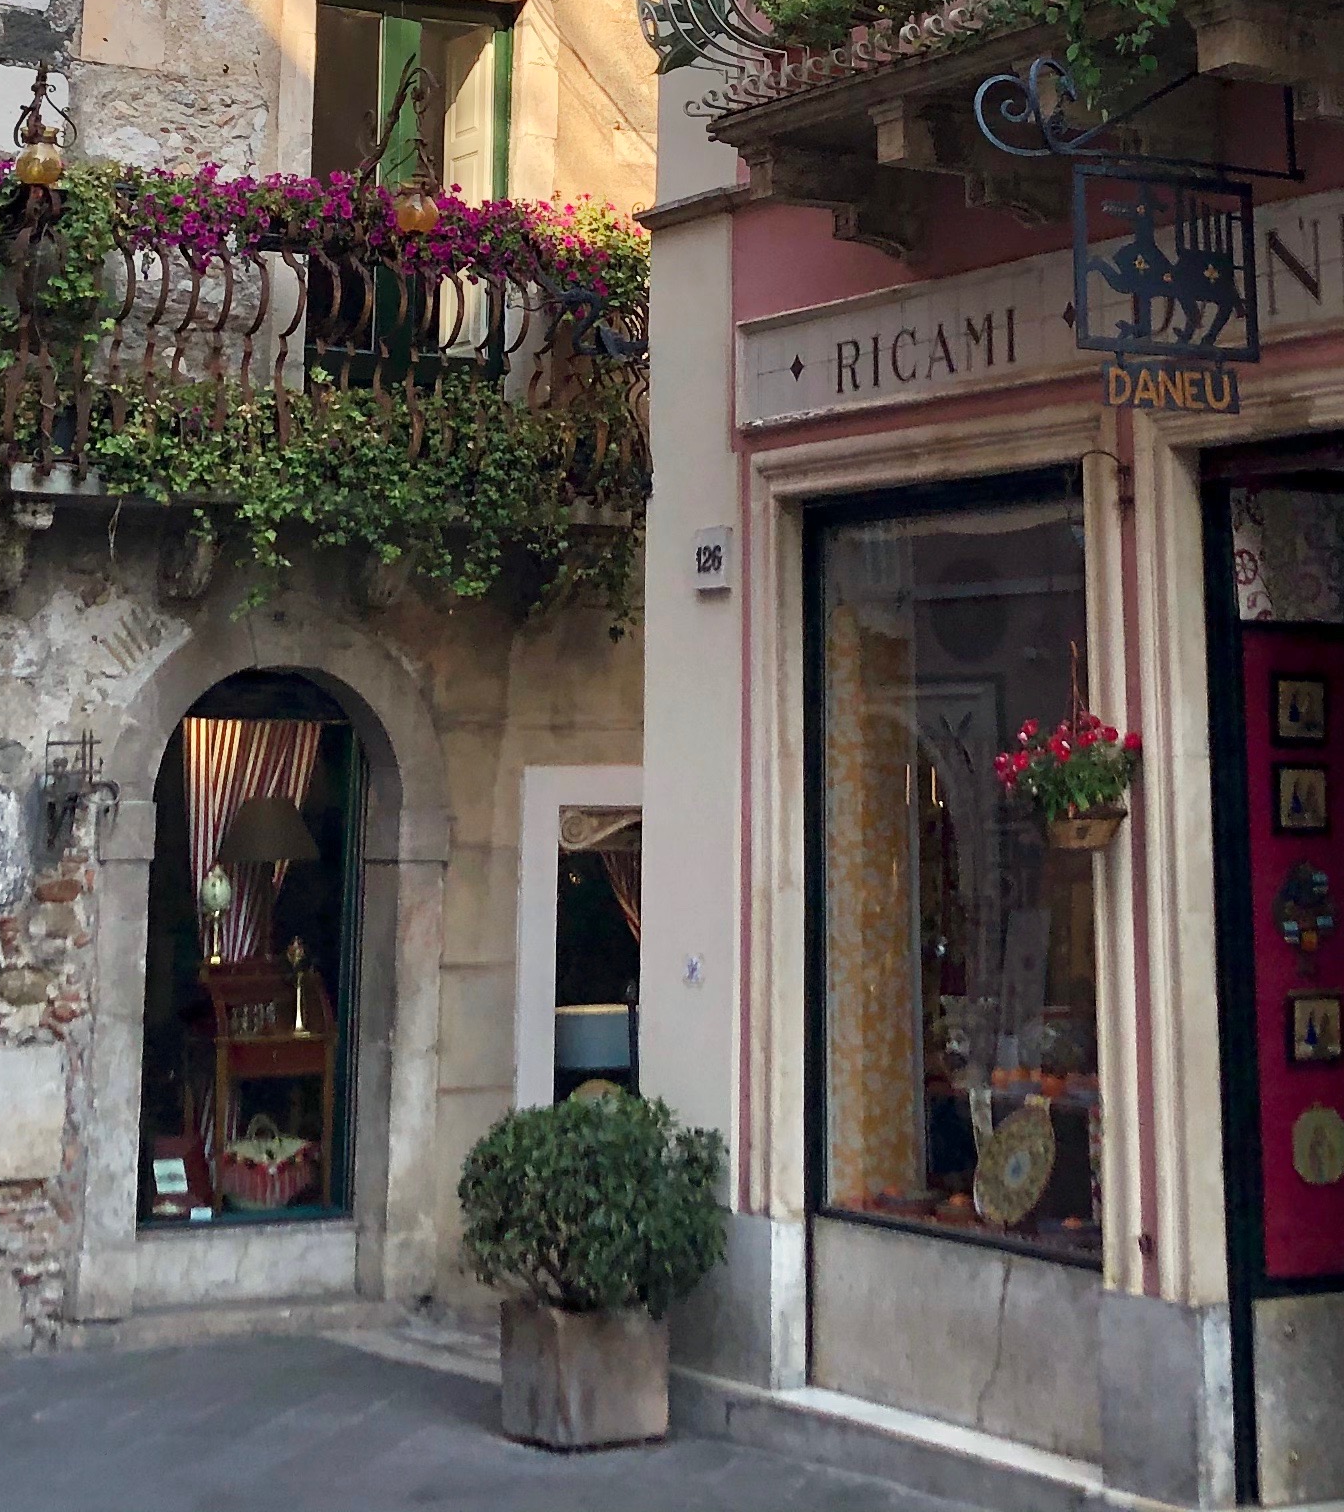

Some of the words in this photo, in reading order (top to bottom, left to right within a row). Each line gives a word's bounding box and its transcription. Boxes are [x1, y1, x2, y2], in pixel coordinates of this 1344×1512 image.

[835, 305, 1018, 394] RICAMI
[1107, 367, 1231, 411] DANEU
[695, 544, 723, 575] 126
